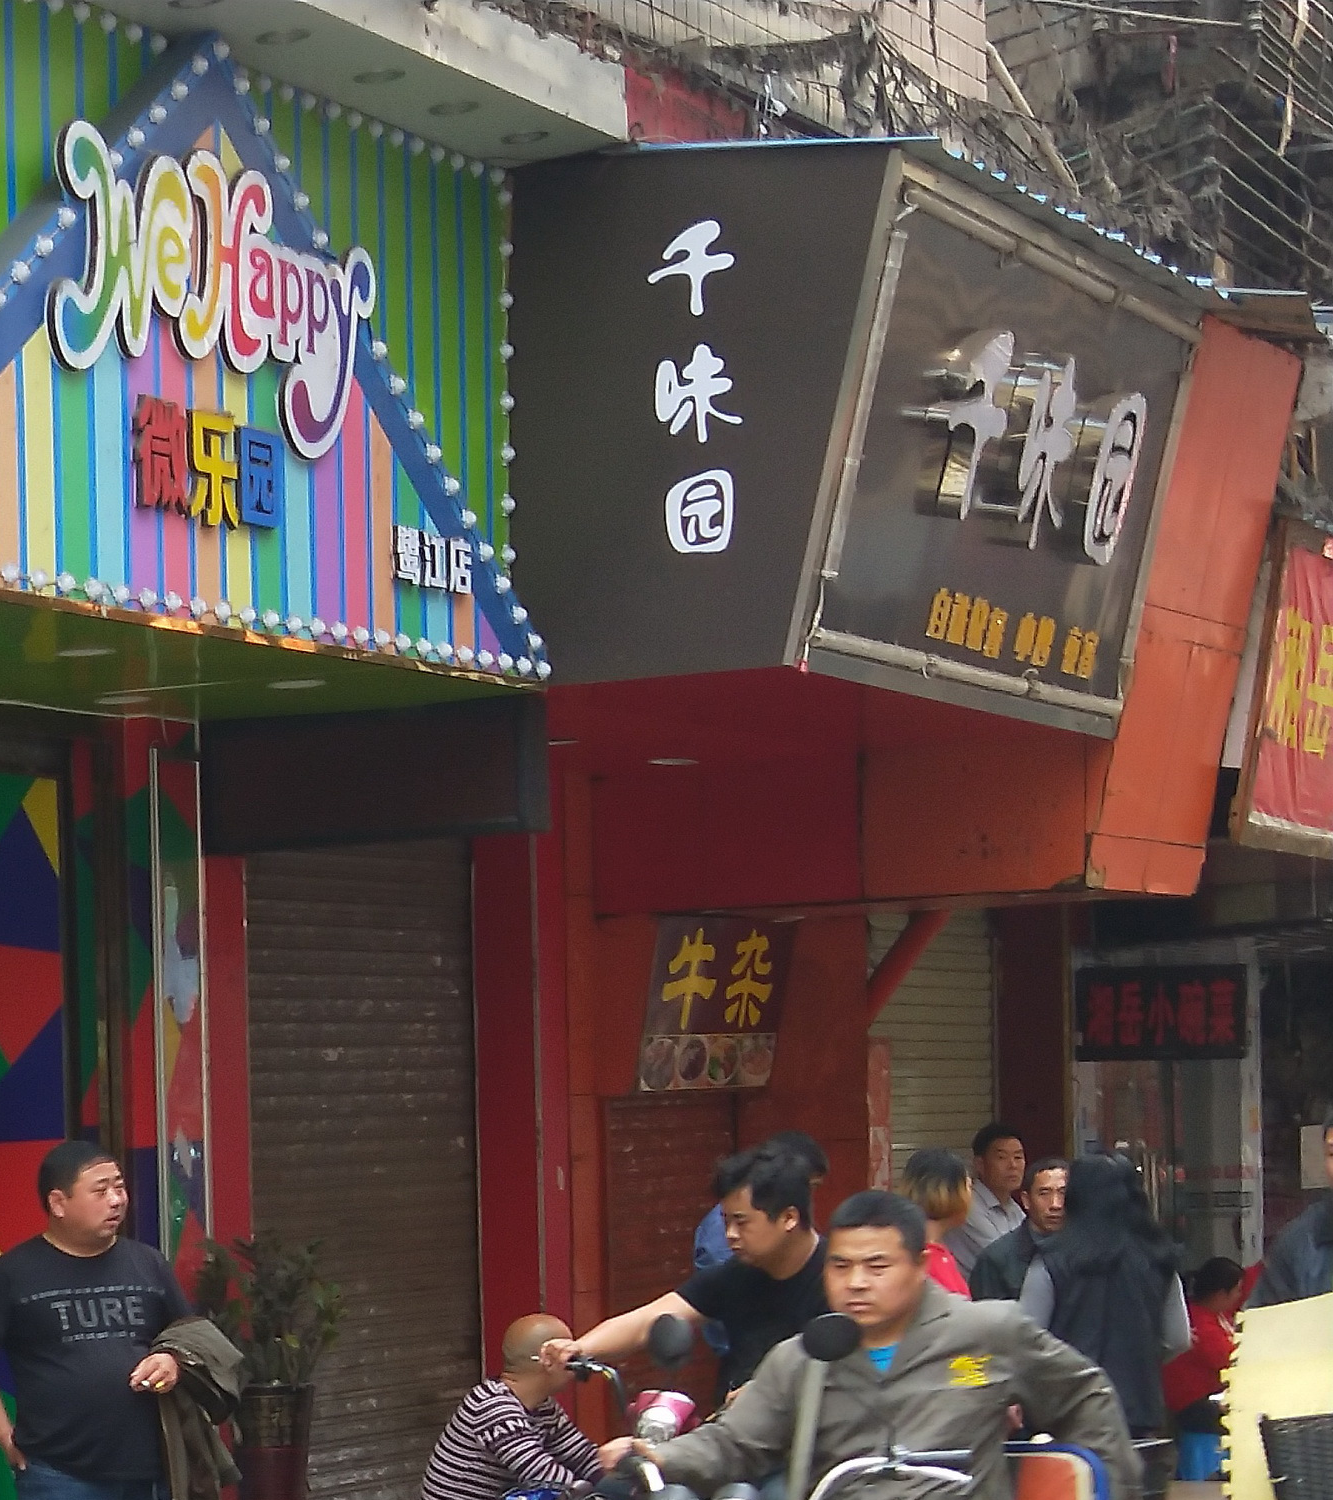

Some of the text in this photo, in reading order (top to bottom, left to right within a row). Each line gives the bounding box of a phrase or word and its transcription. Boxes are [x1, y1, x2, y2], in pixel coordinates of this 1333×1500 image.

[647, 219, 742, 554] 千味园
[137, 394, 284, 530] 微乐园
[662, 925, 773, 1032] 牛杂
[50, 1295, 146, 1331] TURE
